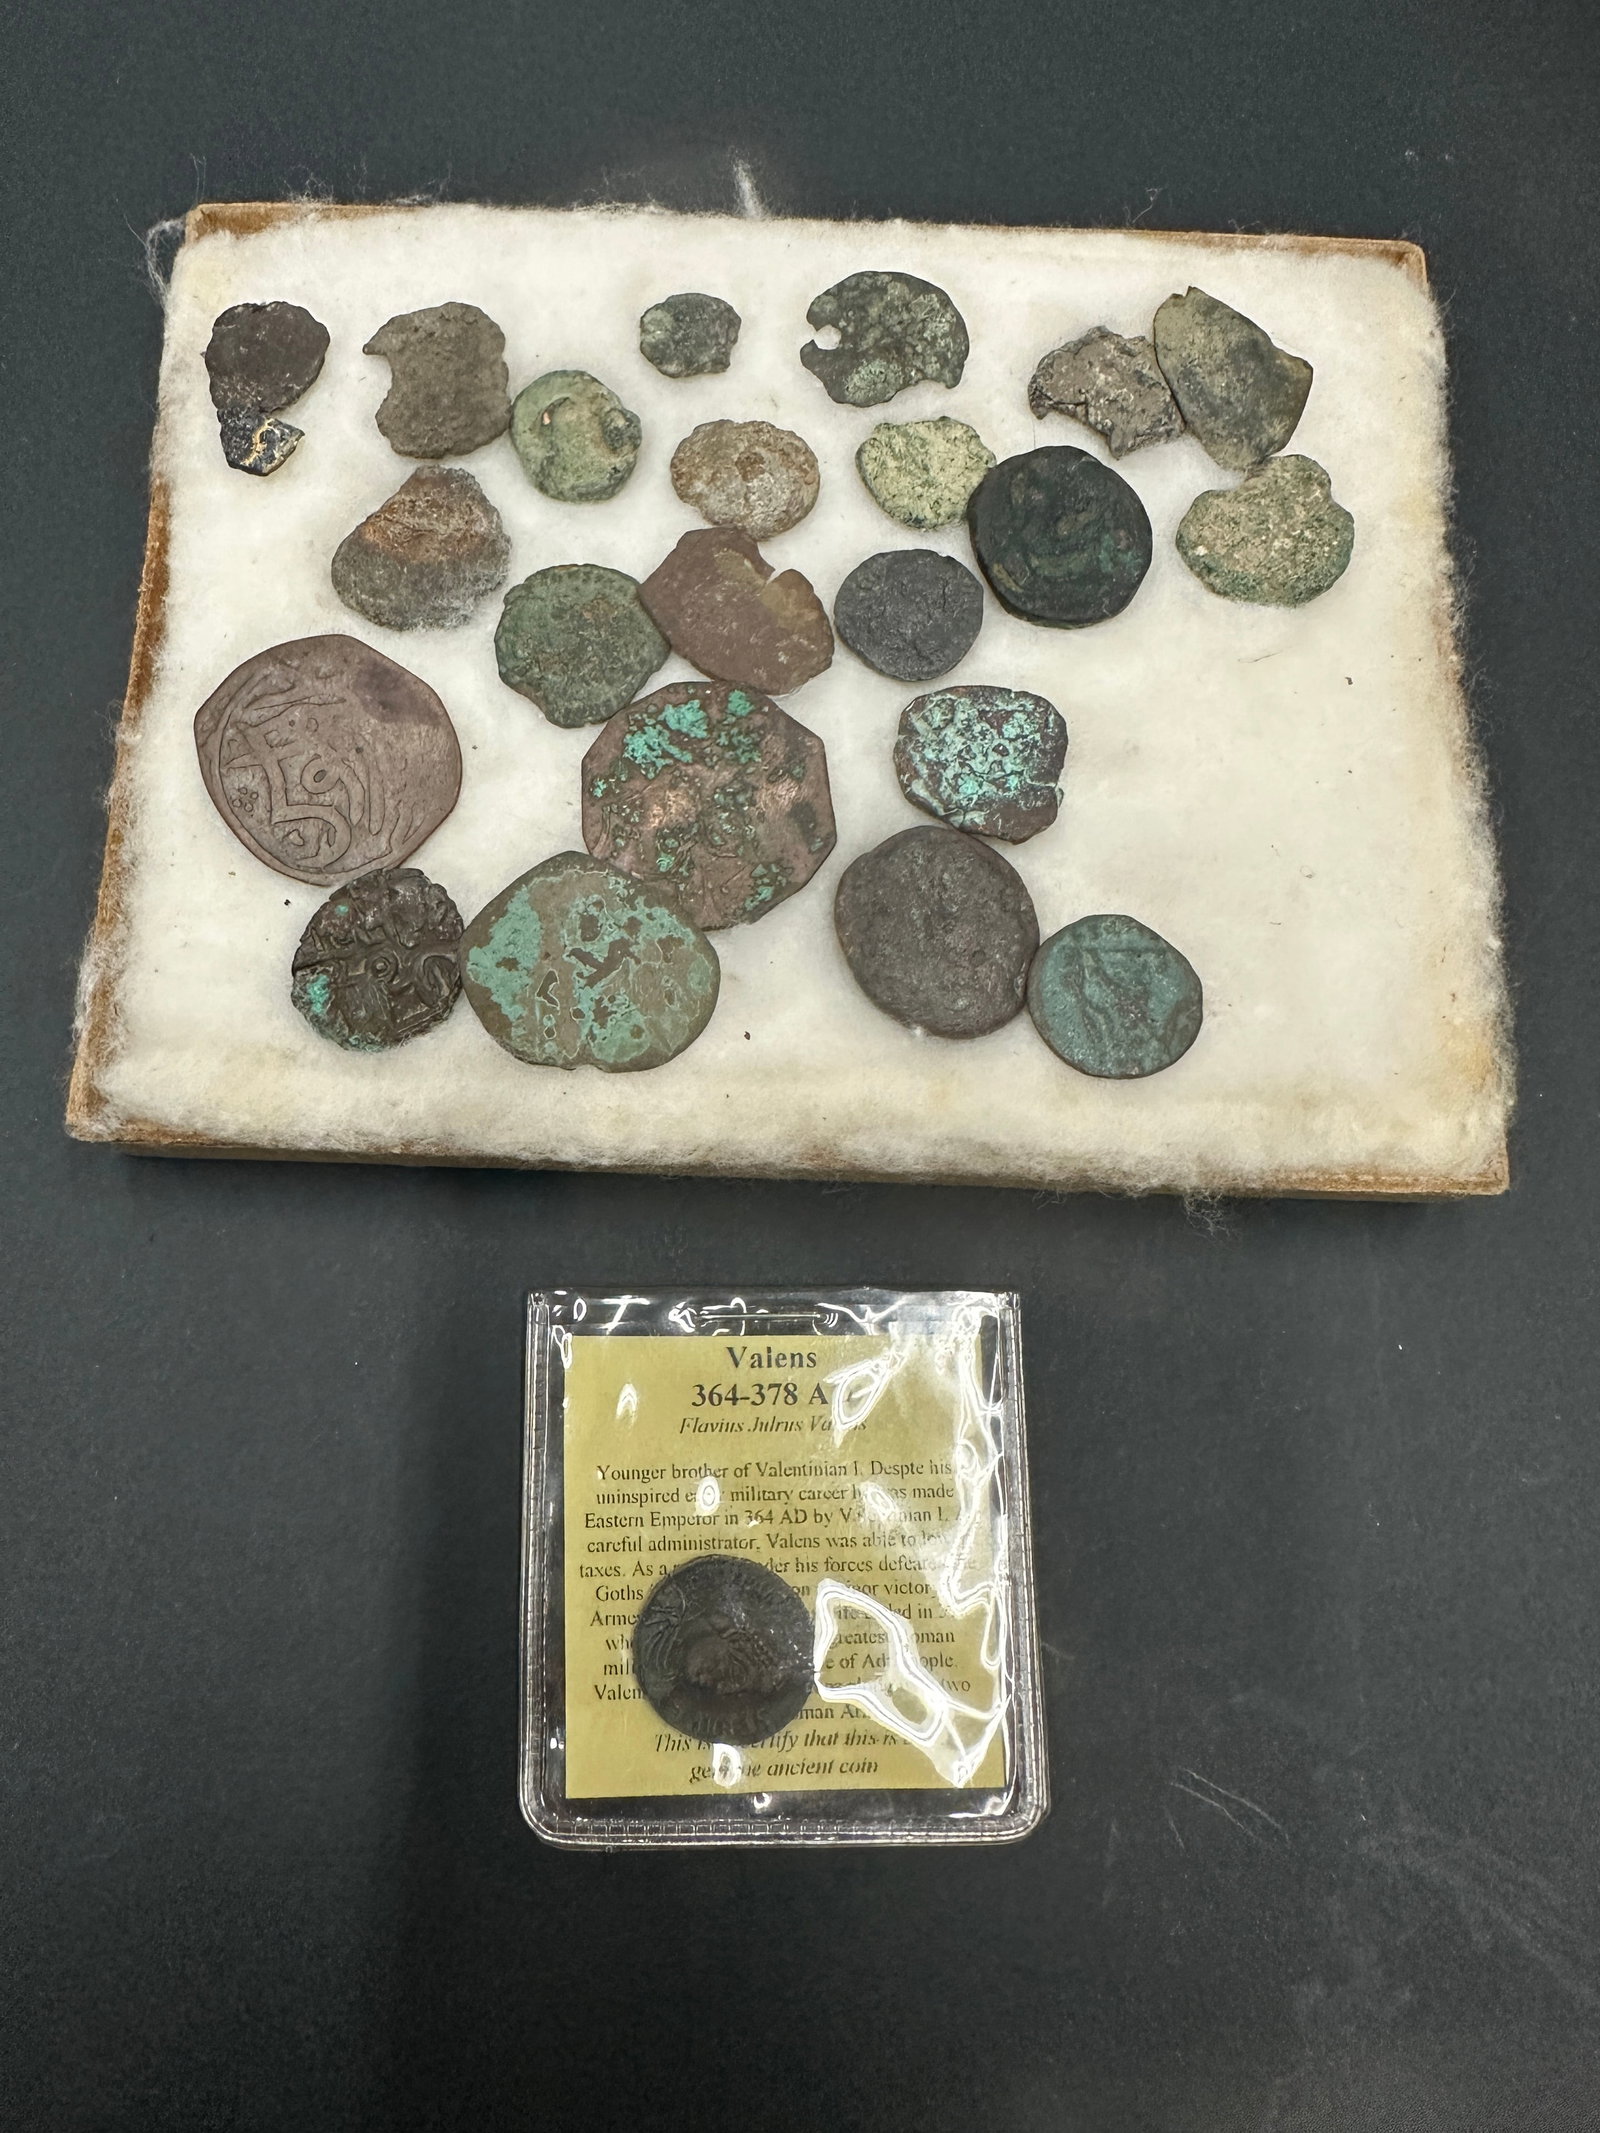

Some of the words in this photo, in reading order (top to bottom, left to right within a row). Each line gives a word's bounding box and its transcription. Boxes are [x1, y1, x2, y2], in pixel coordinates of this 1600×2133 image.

[691, 1383, 799, 1406] 364-378
[680, 1417, 744, 1434] Flavius
[597, 1465, 667, 1483] Younger
[672, 1464, 728, 1479] brother
[734, 1463, 752, 1477] of
[756, 1461, 847, 1477] Valentinian
[930, 1459, 952, 1474] his
[596, 1487, 680, 1507] uninspired
[731, 1487, 794, 1504] military
[799, 1487, 848, 1500] career
[912, 1484, 954, 1498] made
[585, 1512, 644, 1528] Eastern
[650, 1511, 717, 1530] Emperor
[725, 1505, 738, 1524] in
[744, 1510, 773, 1526] 364
[779, 1508, 808, 1524] AD
[813, 1508, 833, 1527] by
[587, 1535, 642, 1553] careful
[766, 1531, 820, 1548] Valens
[826, 1536, 857, 1548] was
[901, 1533, 916, 1547] to
[580, 1564, 626, 1578] taxes.
[632, 1561, 654, 1577] As
[795, 1556, 818, 1573] his
[824, 1554, 873, 1573] forces
[595, 1584, 644, 1602] Goths
[883, 1580, 938, 1599] victor
[917, 1603, 933, 1619] in
[840, 1653, 858, 1669] of
[655, 1733, 690, 1752] This
[804, 1729, 839, 1747] that
[844, 1727, 876, 1747] this
[767, 1757, 834, 1776] ancient
[839, 1757, 878, 1774] coin
